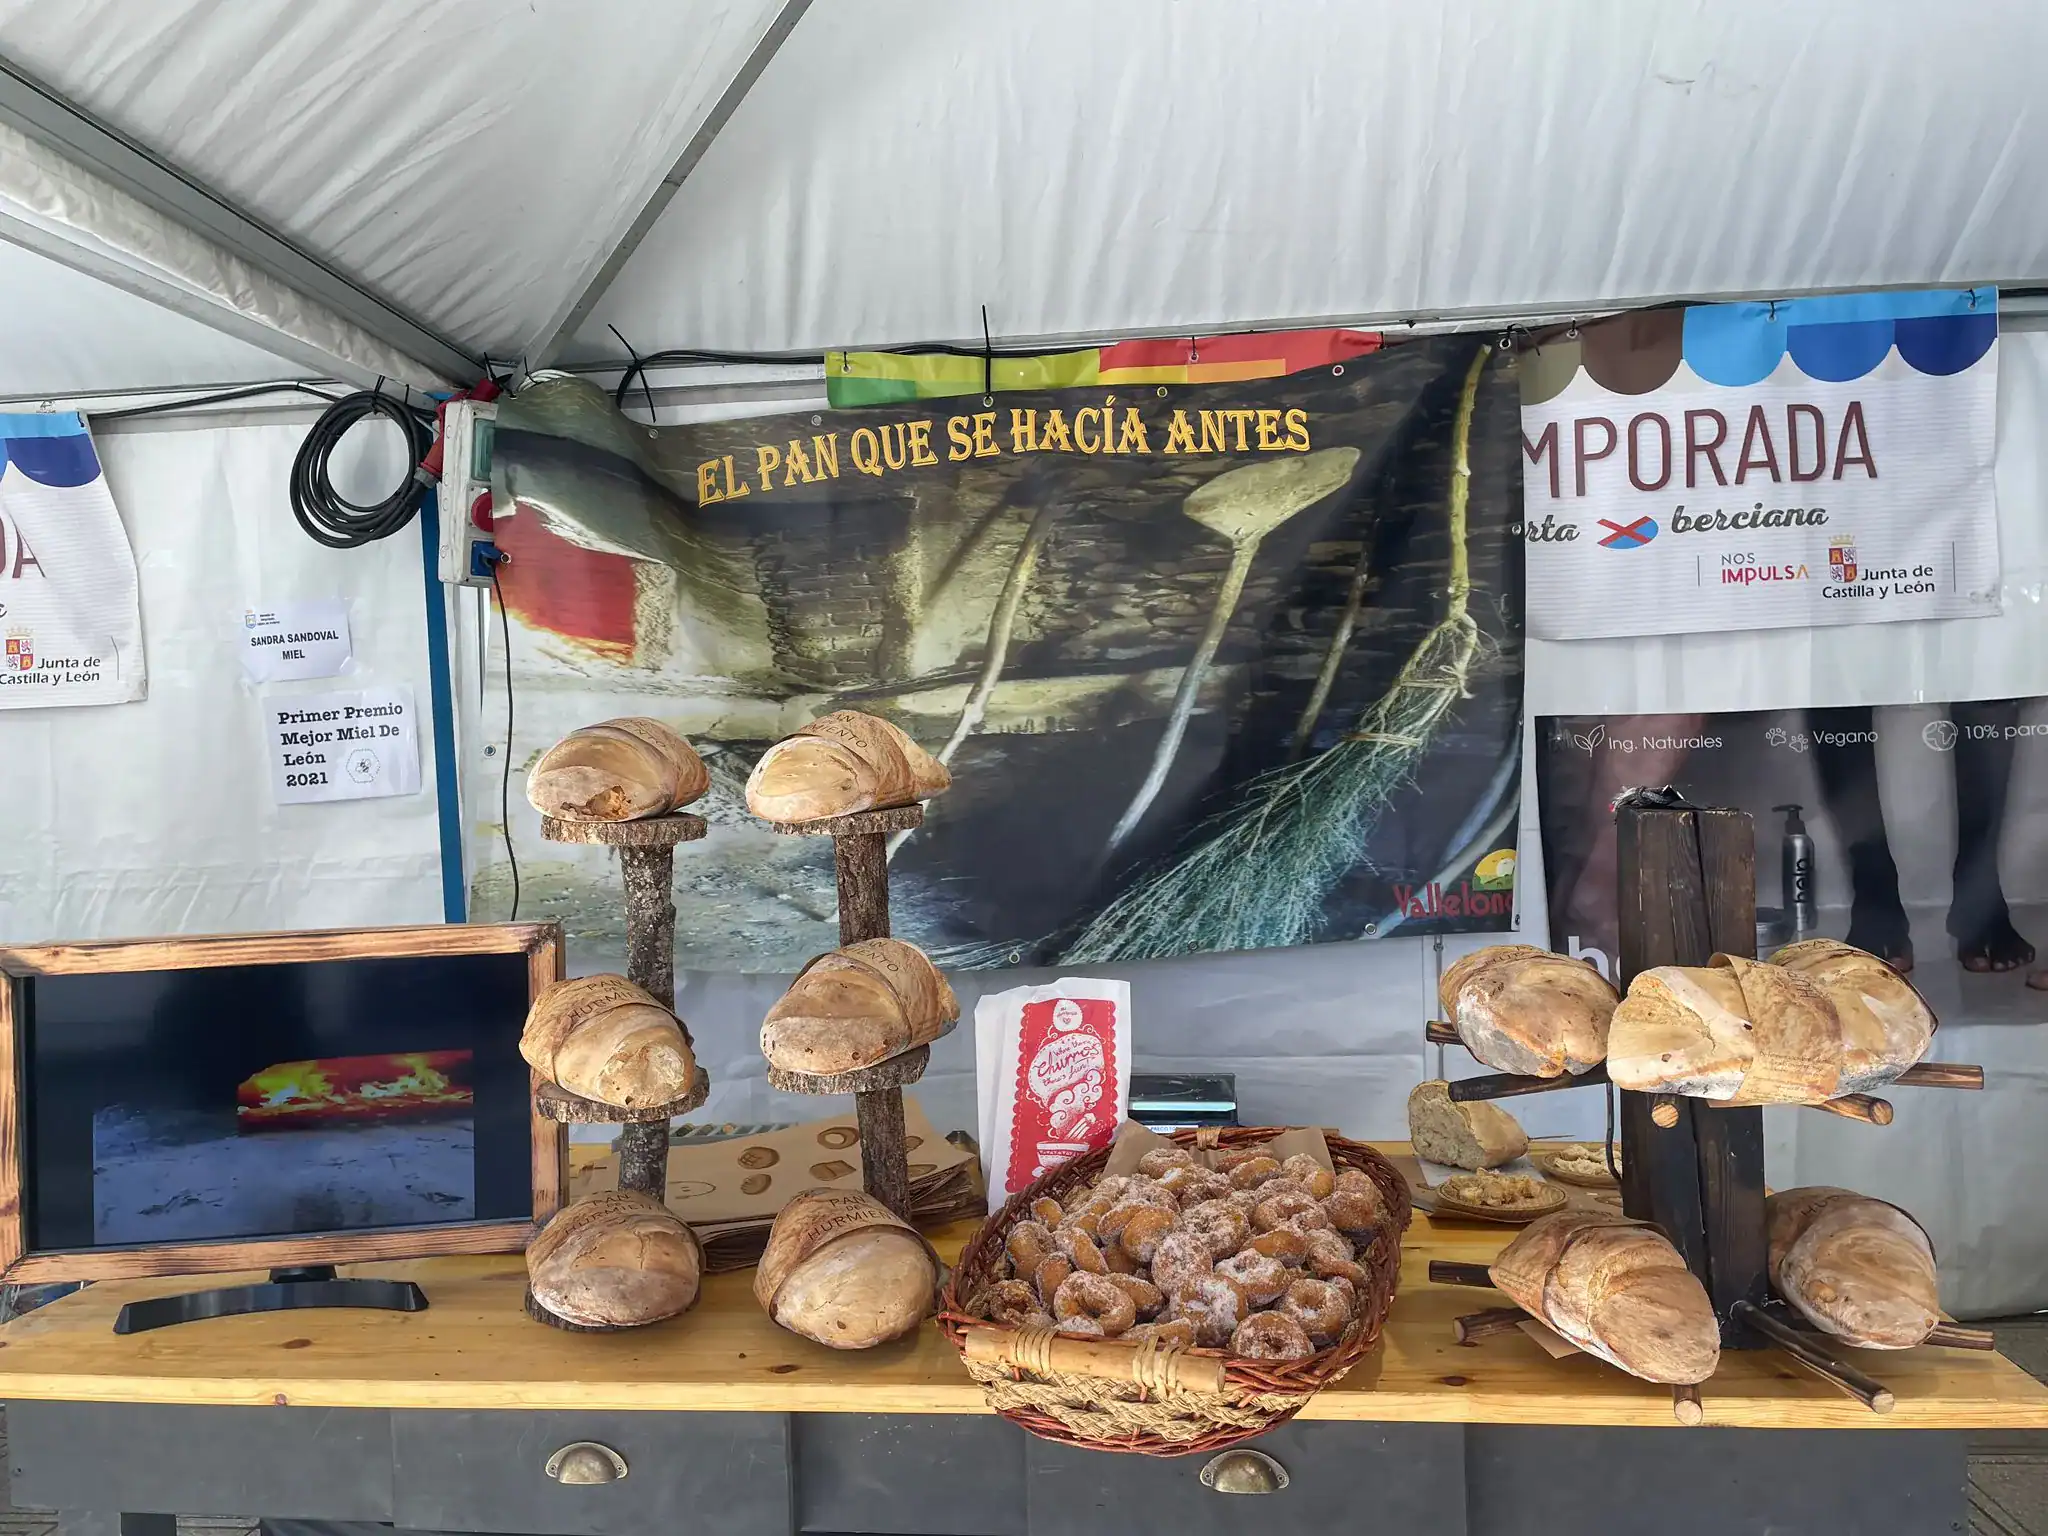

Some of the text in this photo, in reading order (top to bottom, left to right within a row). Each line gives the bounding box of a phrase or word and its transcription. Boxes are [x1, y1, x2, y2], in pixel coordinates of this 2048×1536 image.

[696, 395, 1311, 508] EL PAN QUE SE HACÍA ANTES
[1671, 502, 1830, 533] berciana
[1721, 553, 1755, 565] NOS
[1861, 565, 1934, 581] Junta de
[1822, 580, 1936, 599] Castilla y León
[251, 630, 339, 647] SANDRA SANDOVAL
[38, 656, 101, 669] Junta de
[282, 649, 306, 660] MIEL
[0, 671, 100, 686] Castilla y León
[277, 702, 403, 725] Primer Premio
[280, 724, 400, 747] Mejor Miel De
[1813, 730, 1879, 747] Vegano
[1965, 724, 2048, 740] 10% para
[1609, 735, 1723, 753] Ing. Naturales
[283, 751, 326, 766] León
[286, 772, 328, 787] 2021
[586, 980, 624, 991] PAN
[829, 1195, 866, 1207] PAN
